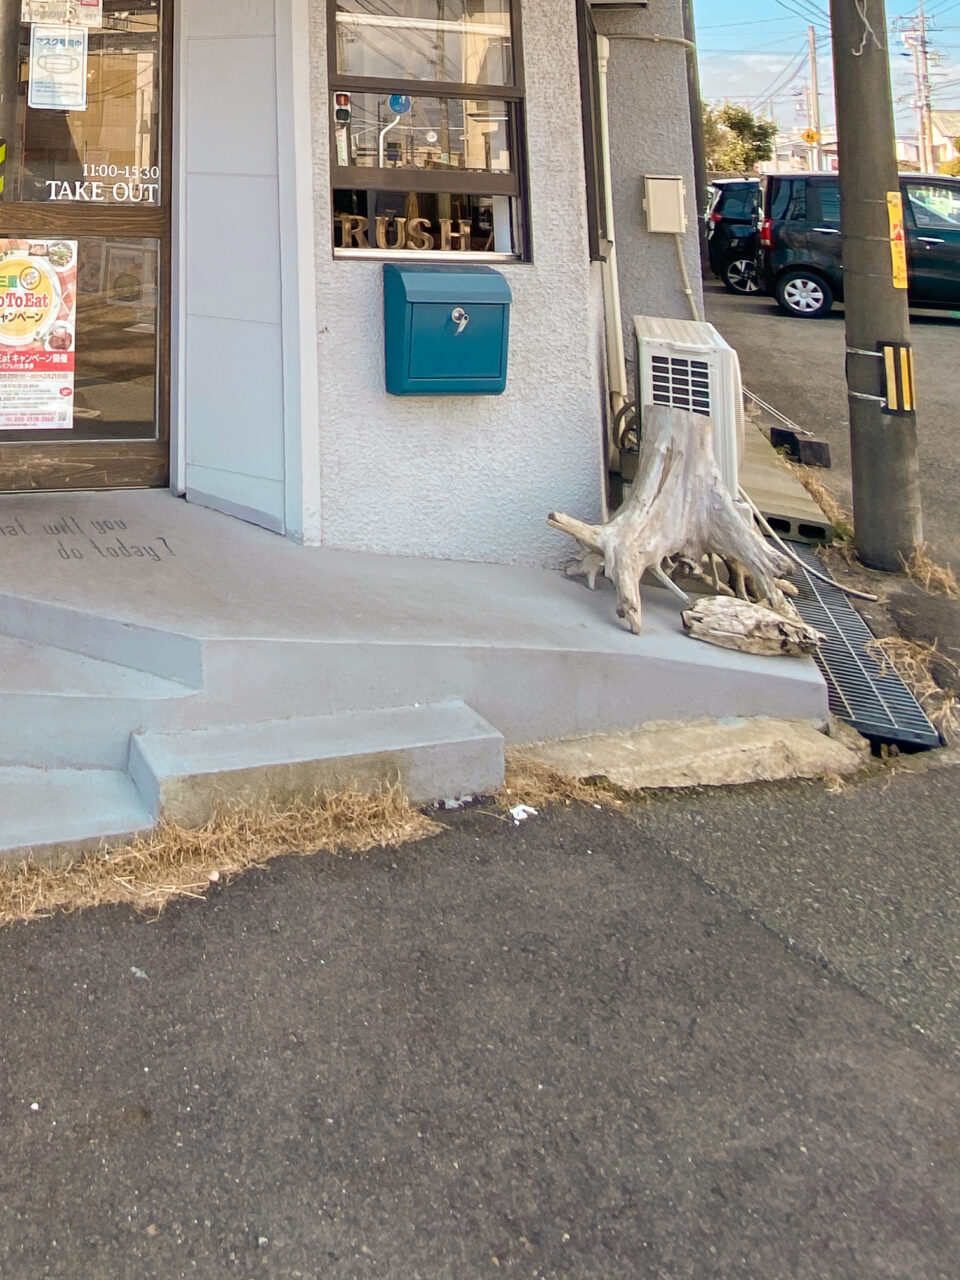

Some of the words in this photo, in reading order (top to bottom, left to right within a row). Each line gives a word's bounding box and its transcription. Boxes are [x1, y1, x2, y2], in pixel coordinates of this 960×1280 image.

[45, 180, 104, 201] TAKE
[112, 182, 159, 202] OUT
[340, 213, 472, 251] RUSH
[42, 516, 85, 537] will
[91, 519, 128, 535] you
[57, 540, 83, 560] do
